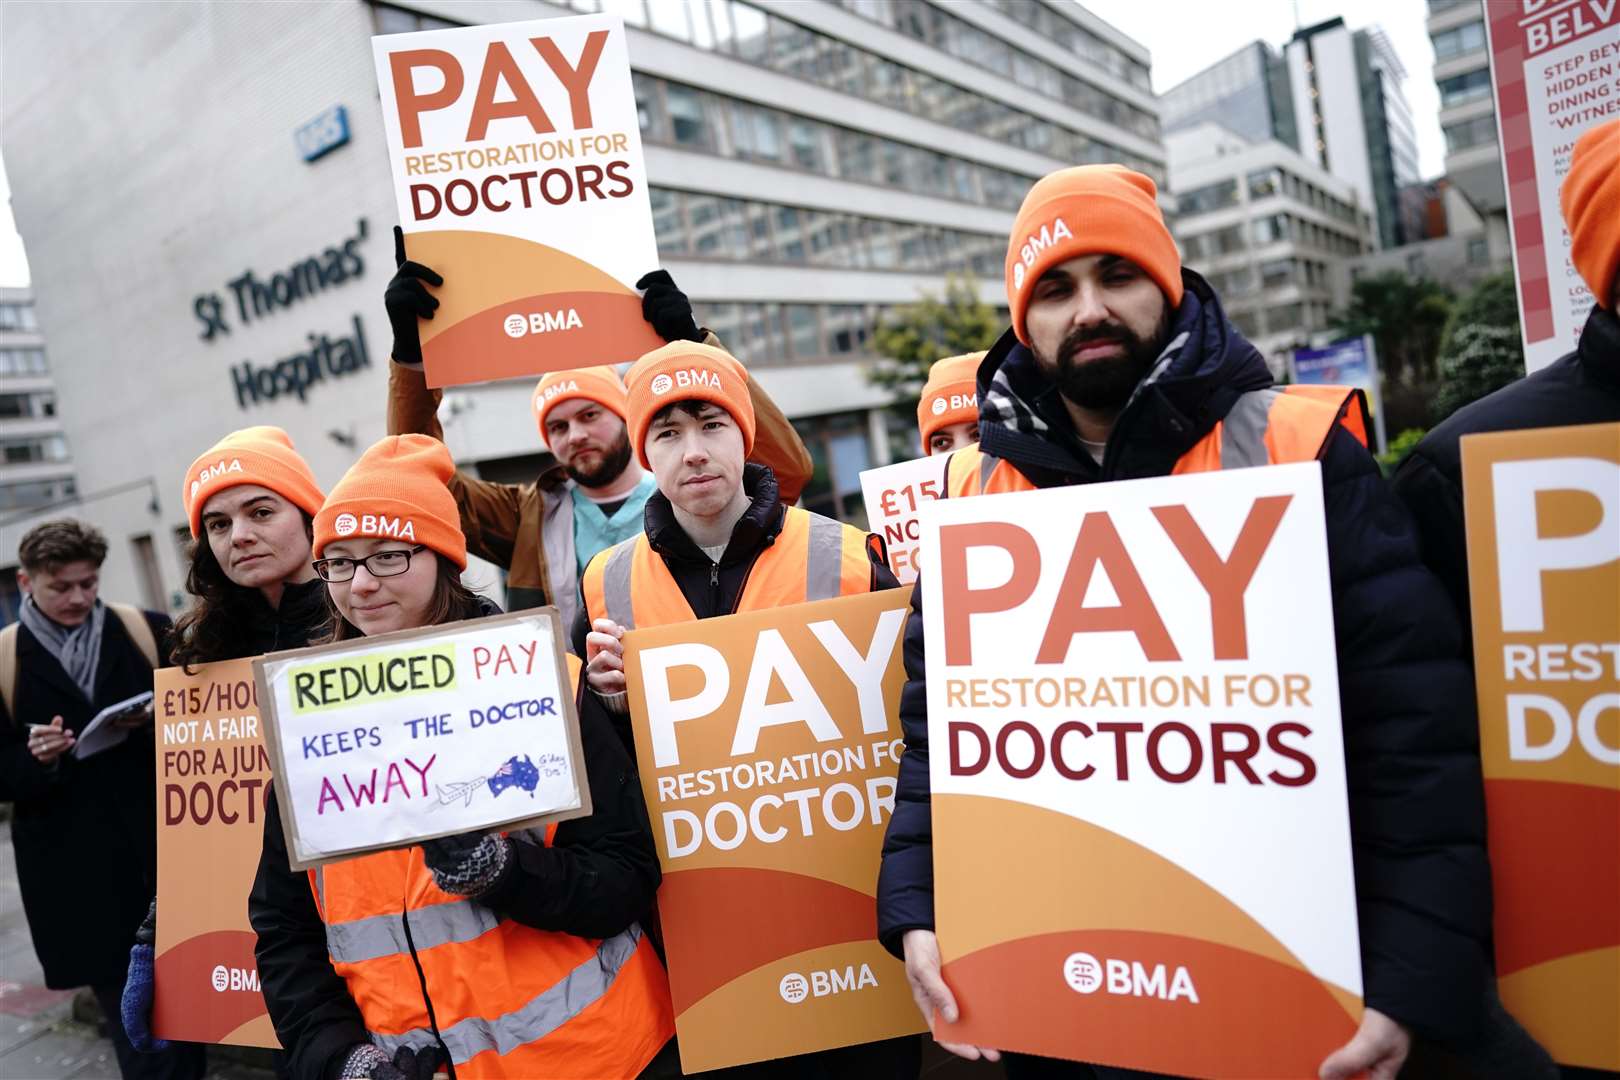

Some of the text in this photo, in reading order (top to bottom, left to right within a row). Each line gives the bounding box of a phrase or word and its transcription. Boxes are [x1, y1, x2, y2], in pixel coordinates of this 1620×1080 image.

[388, 30, 610, 148] PAY
[1544, 55, 1584, 80] STEP
[1546, 63, 1612, 97] HIDDEN
[1548, 83, 1610, 115] DINING
[405, 132, 629, 176] RESTORATION FOR
[409, 160, 634, 221] DOCTORS
[1021, 218, 1073, 268] BMA
[193, 217, 369, 342] St Thomas'
[528, 308, 583, 334] BMA
[231, 313, 371, 409] Hospital
[675, 368, 722, 391] BMA
[543, 380, 580, 400] BMA
[200, 458, 243, 483] BMA
[361, 514, 416, 541] BMA
[939, 494, 1295, 666] PAY
[294, 640, 537, 709] REDUCED PAY
[639, 607, 908, 768] PAY
[945, 673, 1313, 708] RESTORATION FOR
[163, 715, 259, 745] NOT A FAIR
[302, 697, 557, 760] KEEPS THE DOCTOR
[164, 748, 206, 778] FOR
[212, 747, 227, 775] A
[657, 745, 866, 802] RESTORATION
[948, 720, 1317, 788] DOCTORS
[317, 753, 437, 815] AWAY
[810, 963, 878, 997] BMA
[1106, 958, 1200, 1004] BMA
